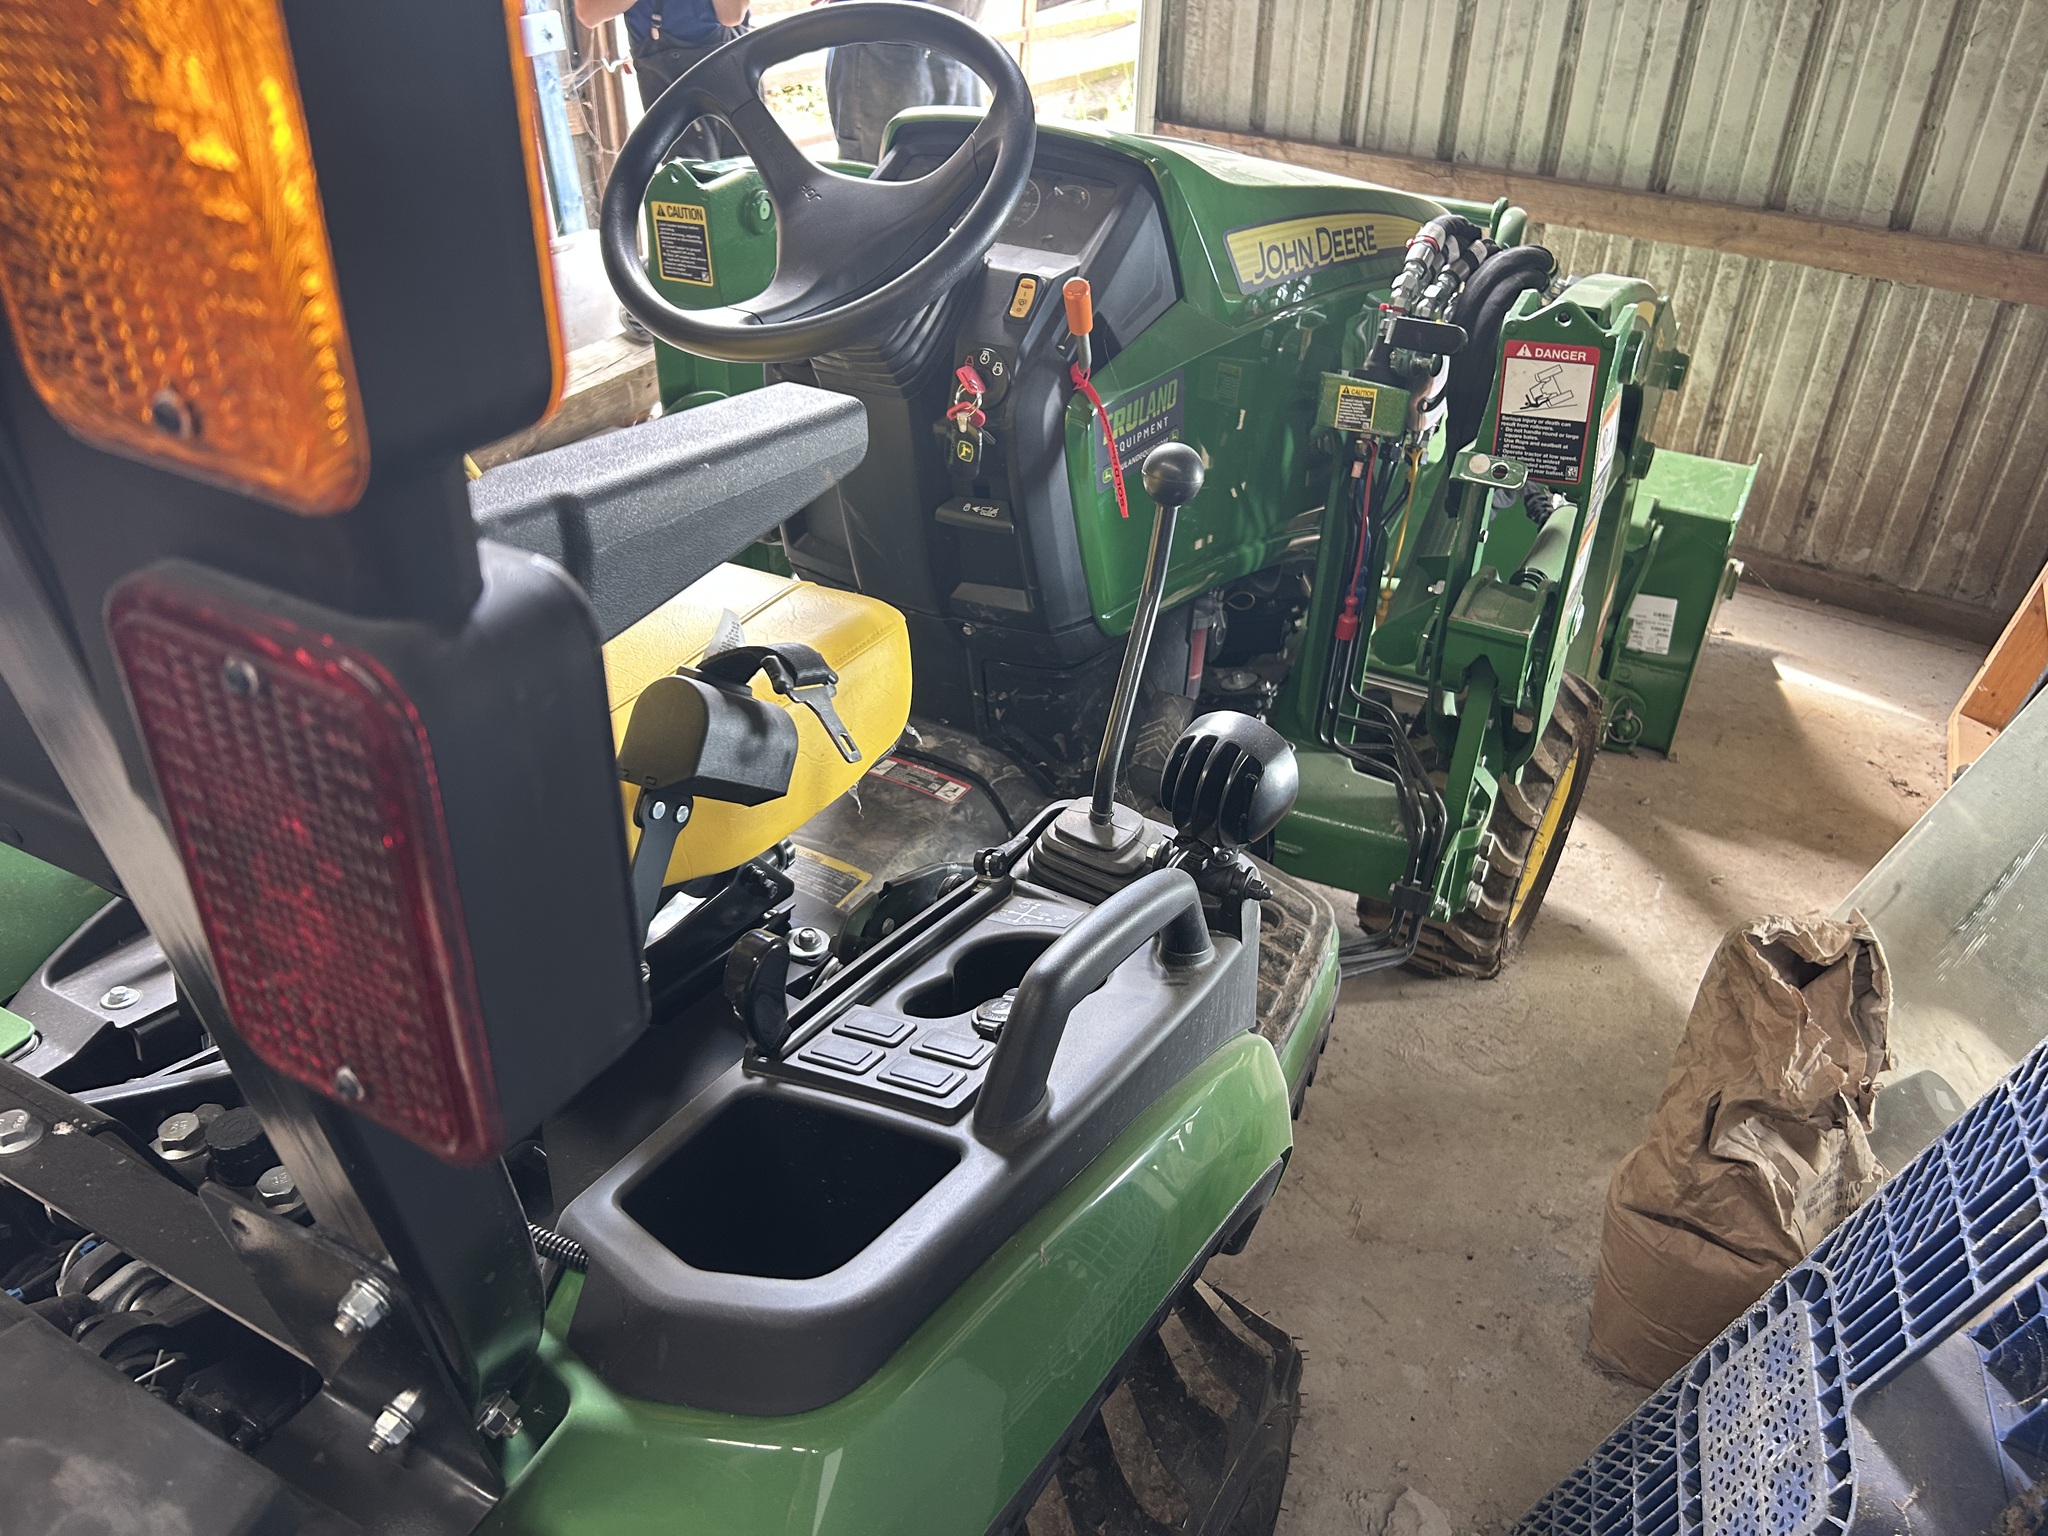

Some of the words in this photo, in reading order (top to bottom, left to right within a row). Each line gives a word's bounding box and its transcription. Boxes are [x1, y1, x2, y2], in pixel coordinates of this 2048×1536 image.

[666, 205, 703, 221] CAUTION
[1254, 236, 1314, 279] JOHN
[1315, 224, 1377, 262] DEERE
[1535, 348, 1587, 362] DANGER
[1351, 388, 1374, 397] CAUTION
[1502, 448, 1523, 456] Operate
[1541, 441, 1562, 449] seatbelt
[1114, 468, 1124, 507] SOLD
